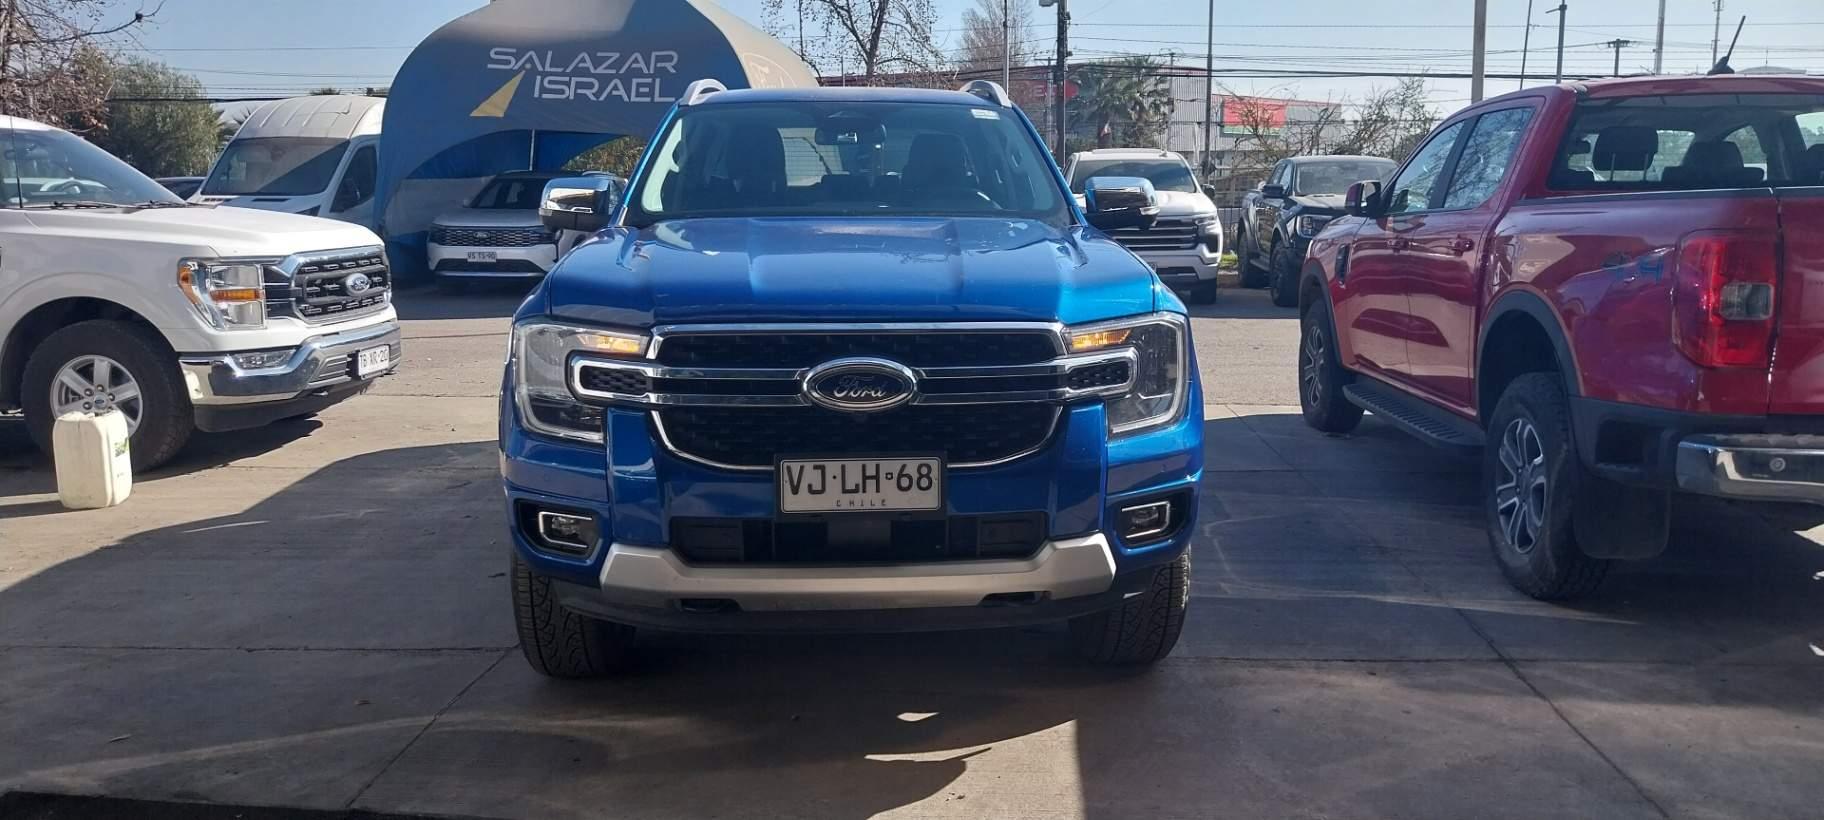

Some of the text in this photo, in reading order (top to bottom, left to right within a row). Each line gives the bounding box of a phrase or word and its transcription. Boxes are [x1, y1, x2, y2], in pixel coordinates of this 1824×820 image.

[487, 47, 679, 74] SALAZAR
[533, 75, 676, 103] ISRAEL
[832, 375, 887, 398] Ford
[835, 499, 887, 507] CHILE
